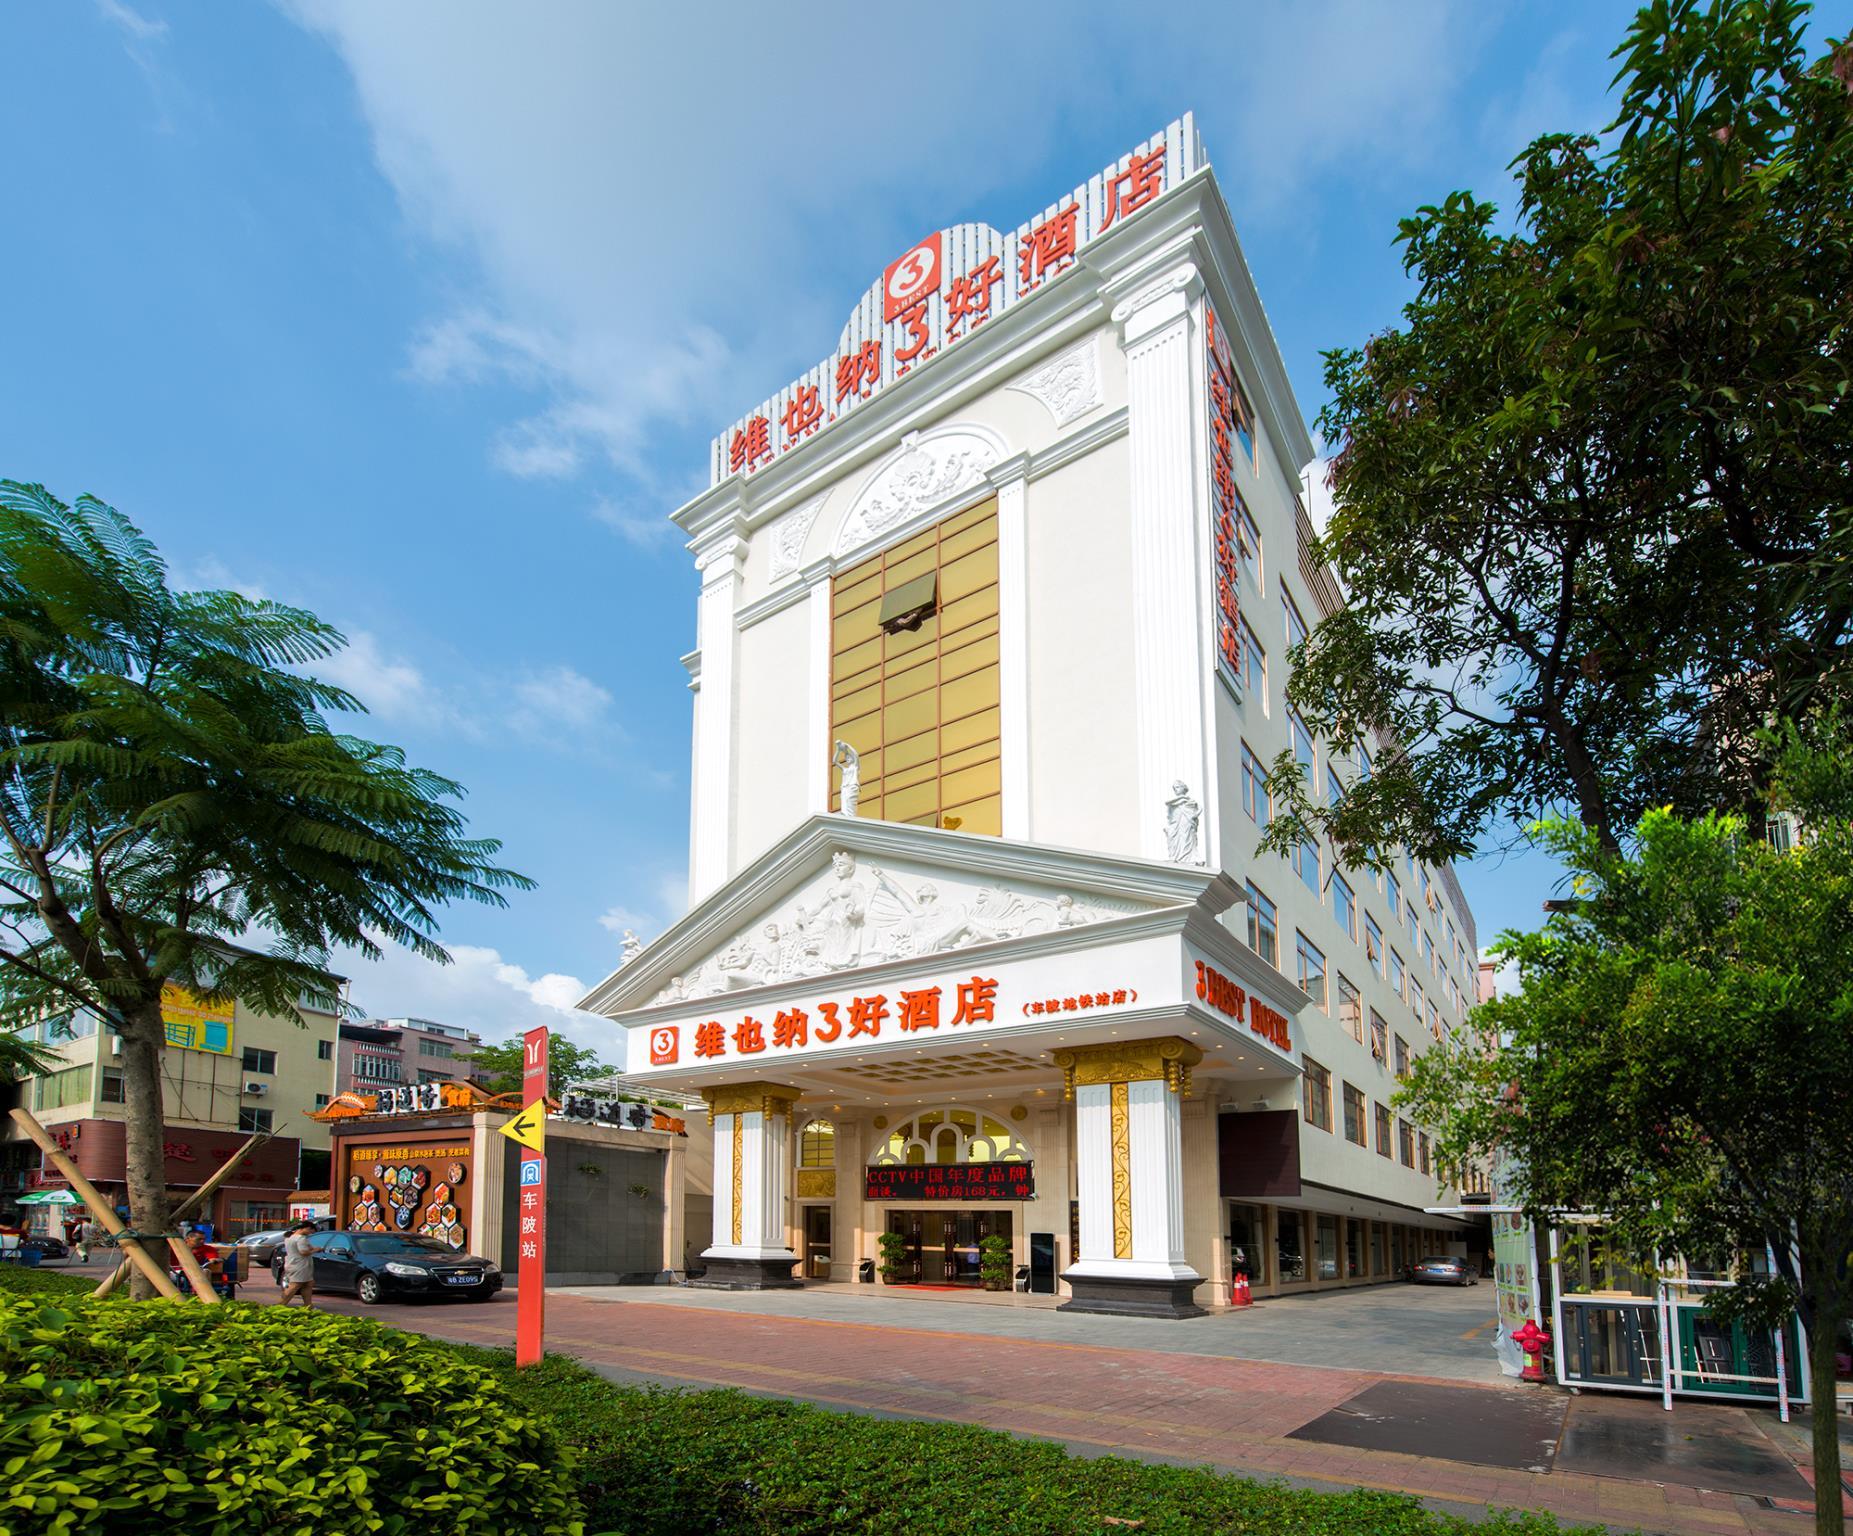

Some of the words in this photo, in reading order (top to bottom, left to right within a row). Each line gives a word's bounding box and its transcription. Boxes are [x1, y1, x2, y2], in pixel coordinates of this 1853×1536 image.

[729, 146, 1166, 472] 维也纳3好酒店
[694, 976, 999, 1058] 维也纳3好酒店
[1249, 996, 1292, 1051] HOTEL
[868, 1166, 1028, 1184] CCTV中国年度品牌
[522, 1192, 538, 1258] 车陂站
